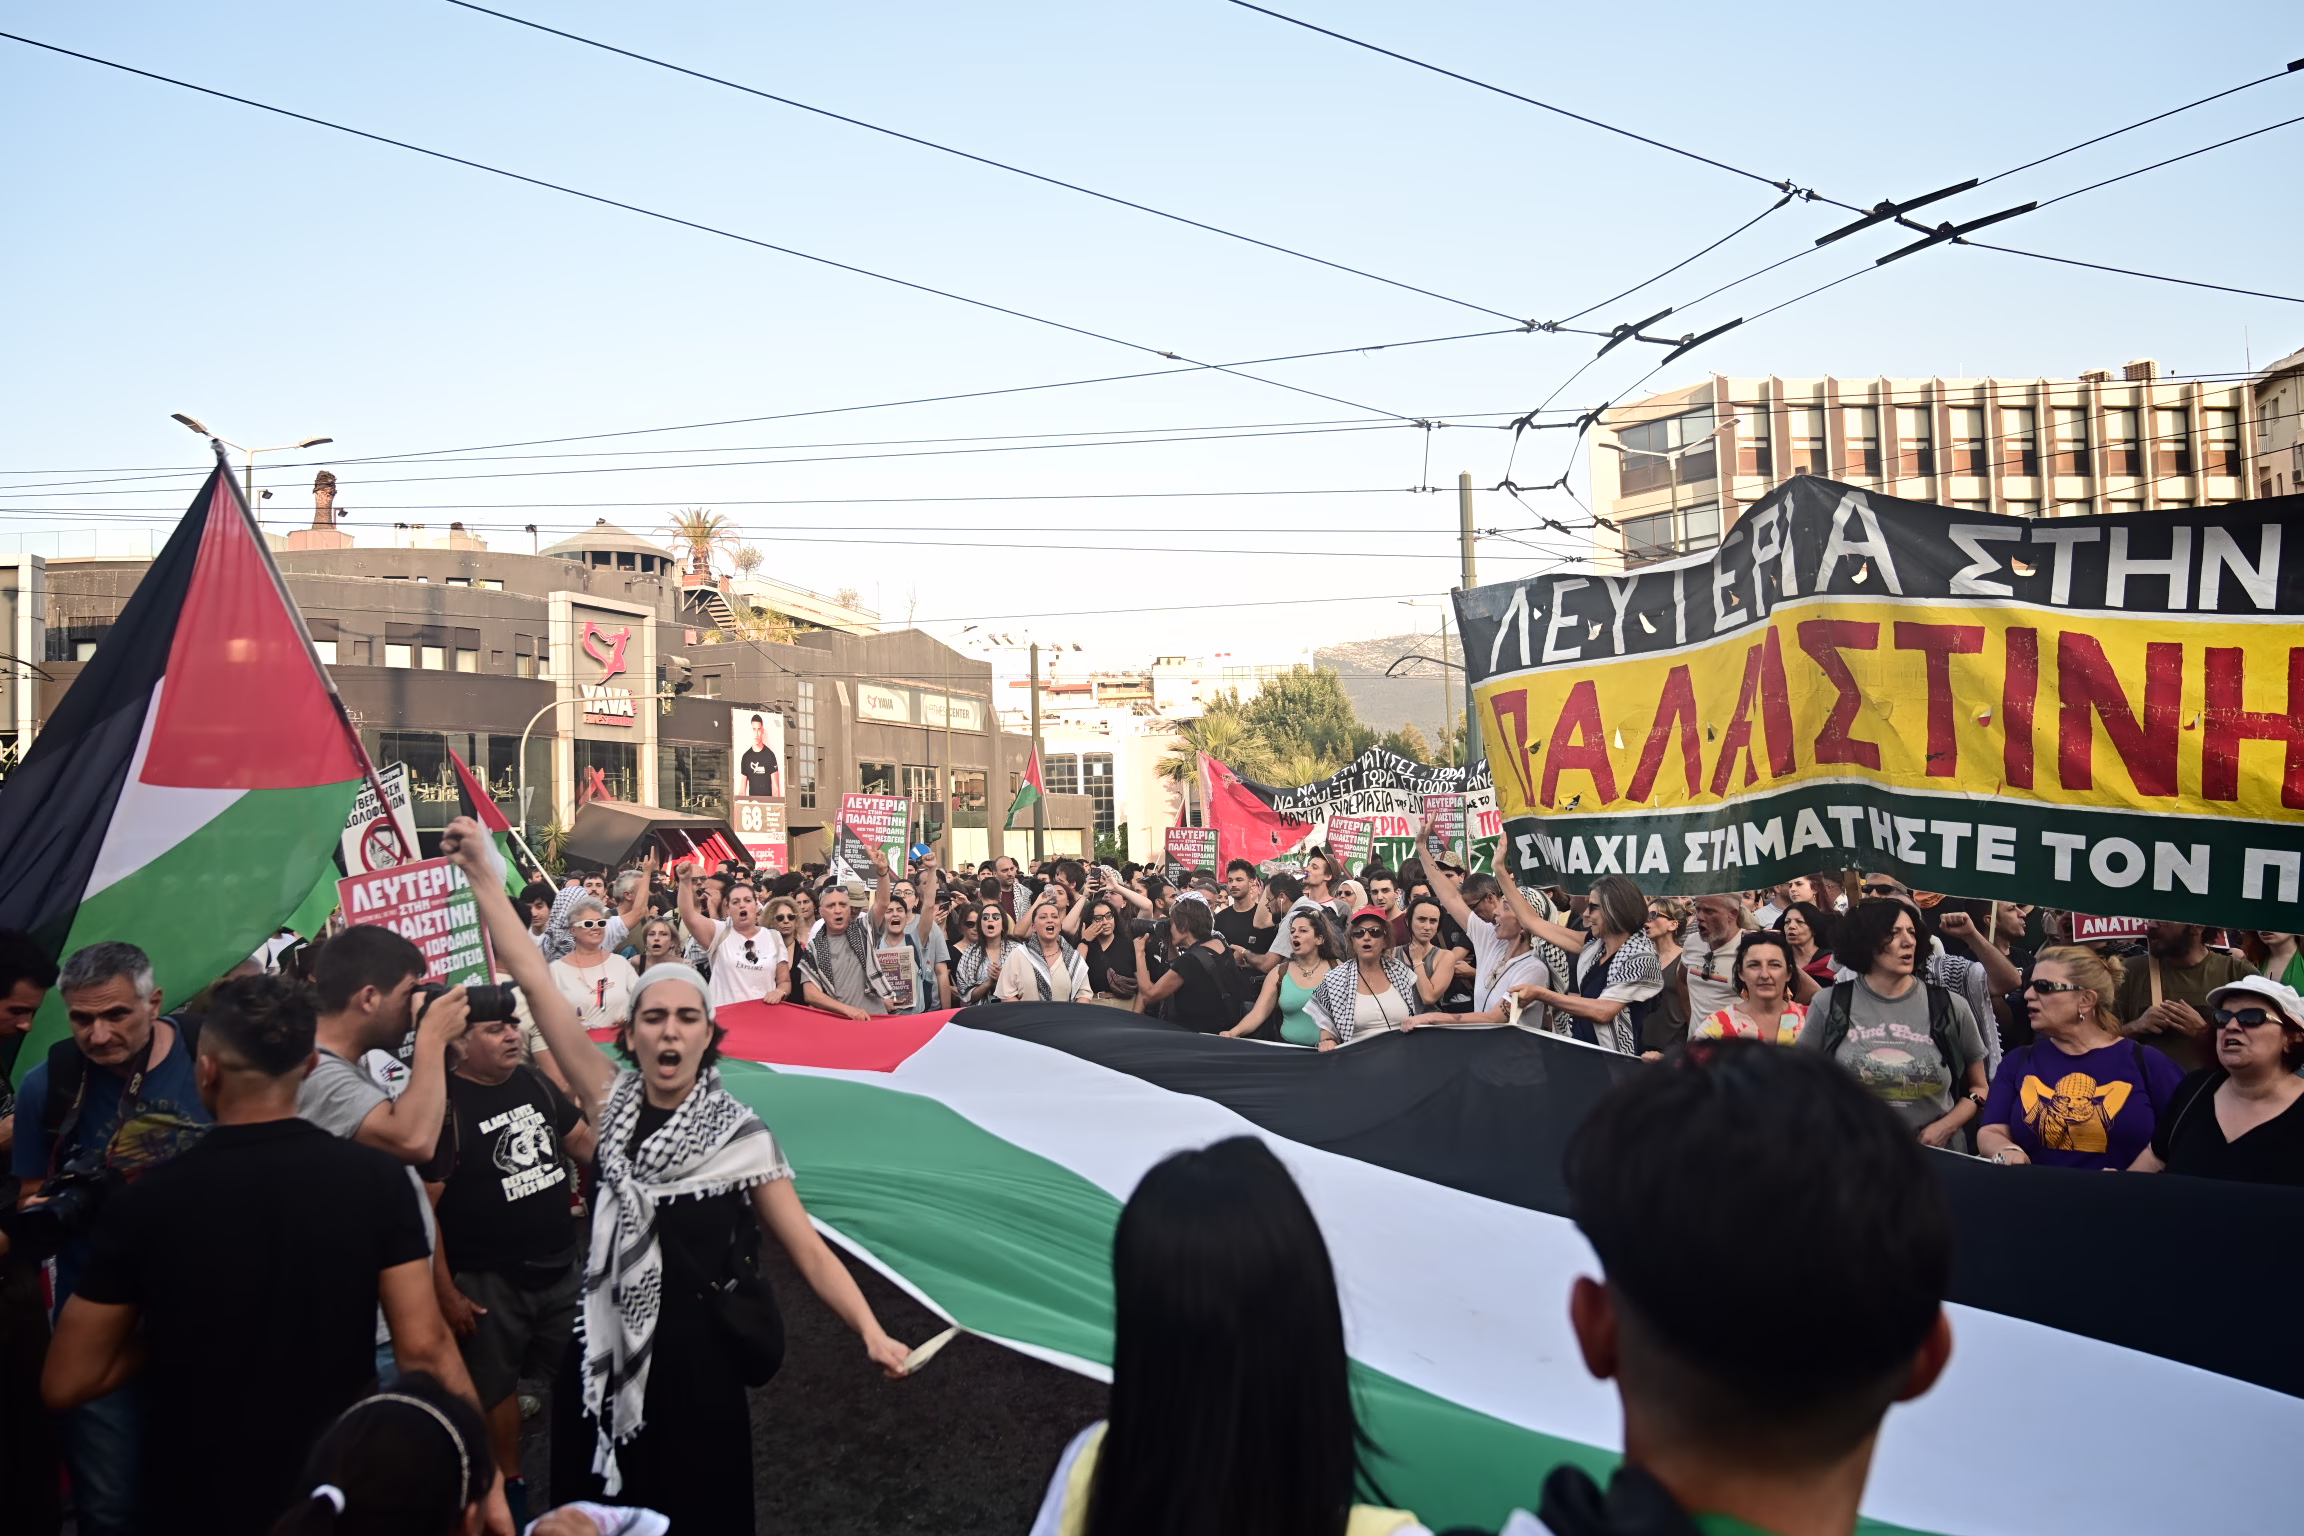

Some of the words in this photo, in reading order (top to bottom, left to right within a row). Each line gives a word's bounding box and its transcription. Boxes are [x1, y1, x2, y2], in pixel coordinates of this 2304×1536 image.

[1949, 524, 2282, 610] ΣΤΗΝ
[581, 684, 635, 717] YAVA
[878, 697, 894, 710] YAVA
[929, 704, 949, 717] FITNES
[1490, 619, 2304, 811] ΠΑΛΑΙΣΤΙΝΗ
[1297, 783, 1317, 798] ΝΑ
[847, 797, 906, 812] ΛΕΥΤΕΡΙΑ
[1273, 795, 1294, 811] ΝΑ
[1426, 797, 1464, 808] ΛΕΥΤΕΡΙΑ
[741, 805, 763, 831] 68
[846, 814, 905, 826] ΠΑΛΑΙΣΤΙΝΗ
[1279, 806, 1325, 827] ΚΑΜΙΑ
[1426, 812, 1464, 822] ΠΛΑΙΣΤΙΝΗ
[1168, 830, 1216, 840] ΛΕΥΤΕΡΙΑ
[1168, 843, 1215, 852] ΠΑΛΑΙΣΤΙΝΗ
[1683, 805, 2017, 875] ΣΤΑΜΑΤΗΣΤΕ
[2041, 830, 2211, 895] ΤΟΝ
[2242, 848, 2302, 903] Π
[352, 865, 471, 913] ΛΕΥΤΕΡΙΑ
[399, 899, 431, 916] ΣΤΗΝ
[382, 901, 477, 941] ΛΑΙΣΤΙΝΗ
[425, 928, 480, 957] ΙΟΡΔΑΝΗ
[430, 947, 485, 977] ΜΕΣΟΓΕΙΟ
[478, 1110, 511, 1135] BLACK
[509, 1103, 536, 1123] LIVES
[505, 1178, 538, 1202] LIVES
